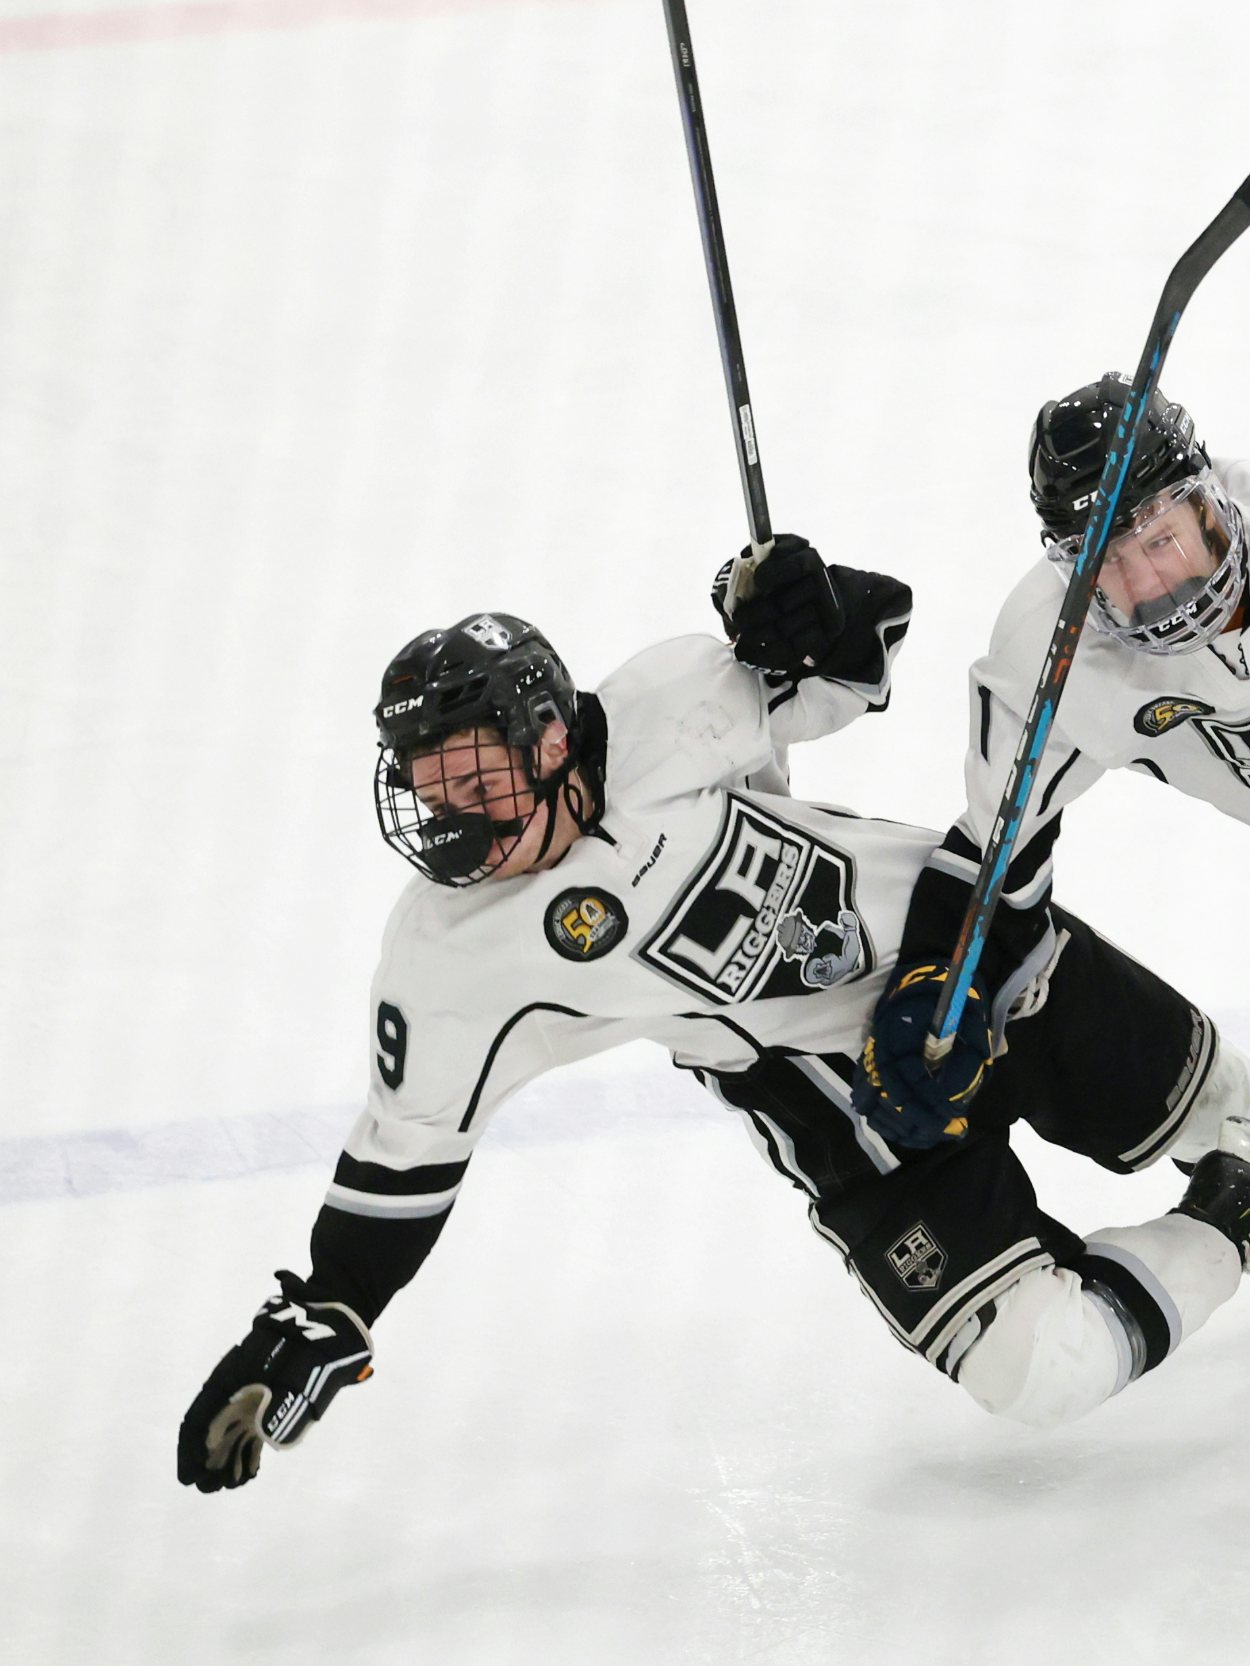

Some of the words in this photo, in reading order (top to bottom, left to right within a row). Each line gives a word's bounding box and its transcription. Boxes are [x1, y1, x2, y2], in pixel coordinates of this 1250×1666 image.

[1158, 598, 1198, 632] CCM
[383, 695, 424, 718] CCM
[632, 832, 667, 888] BAUER
[667, 816, 782, 981] LA
[715, 842, 801, 994] RIGGERS
[376, 1000, 408, 1092] 9
[889, 1229, 929, 1269] LA
[267, 1391, 297, 1432] CCM
